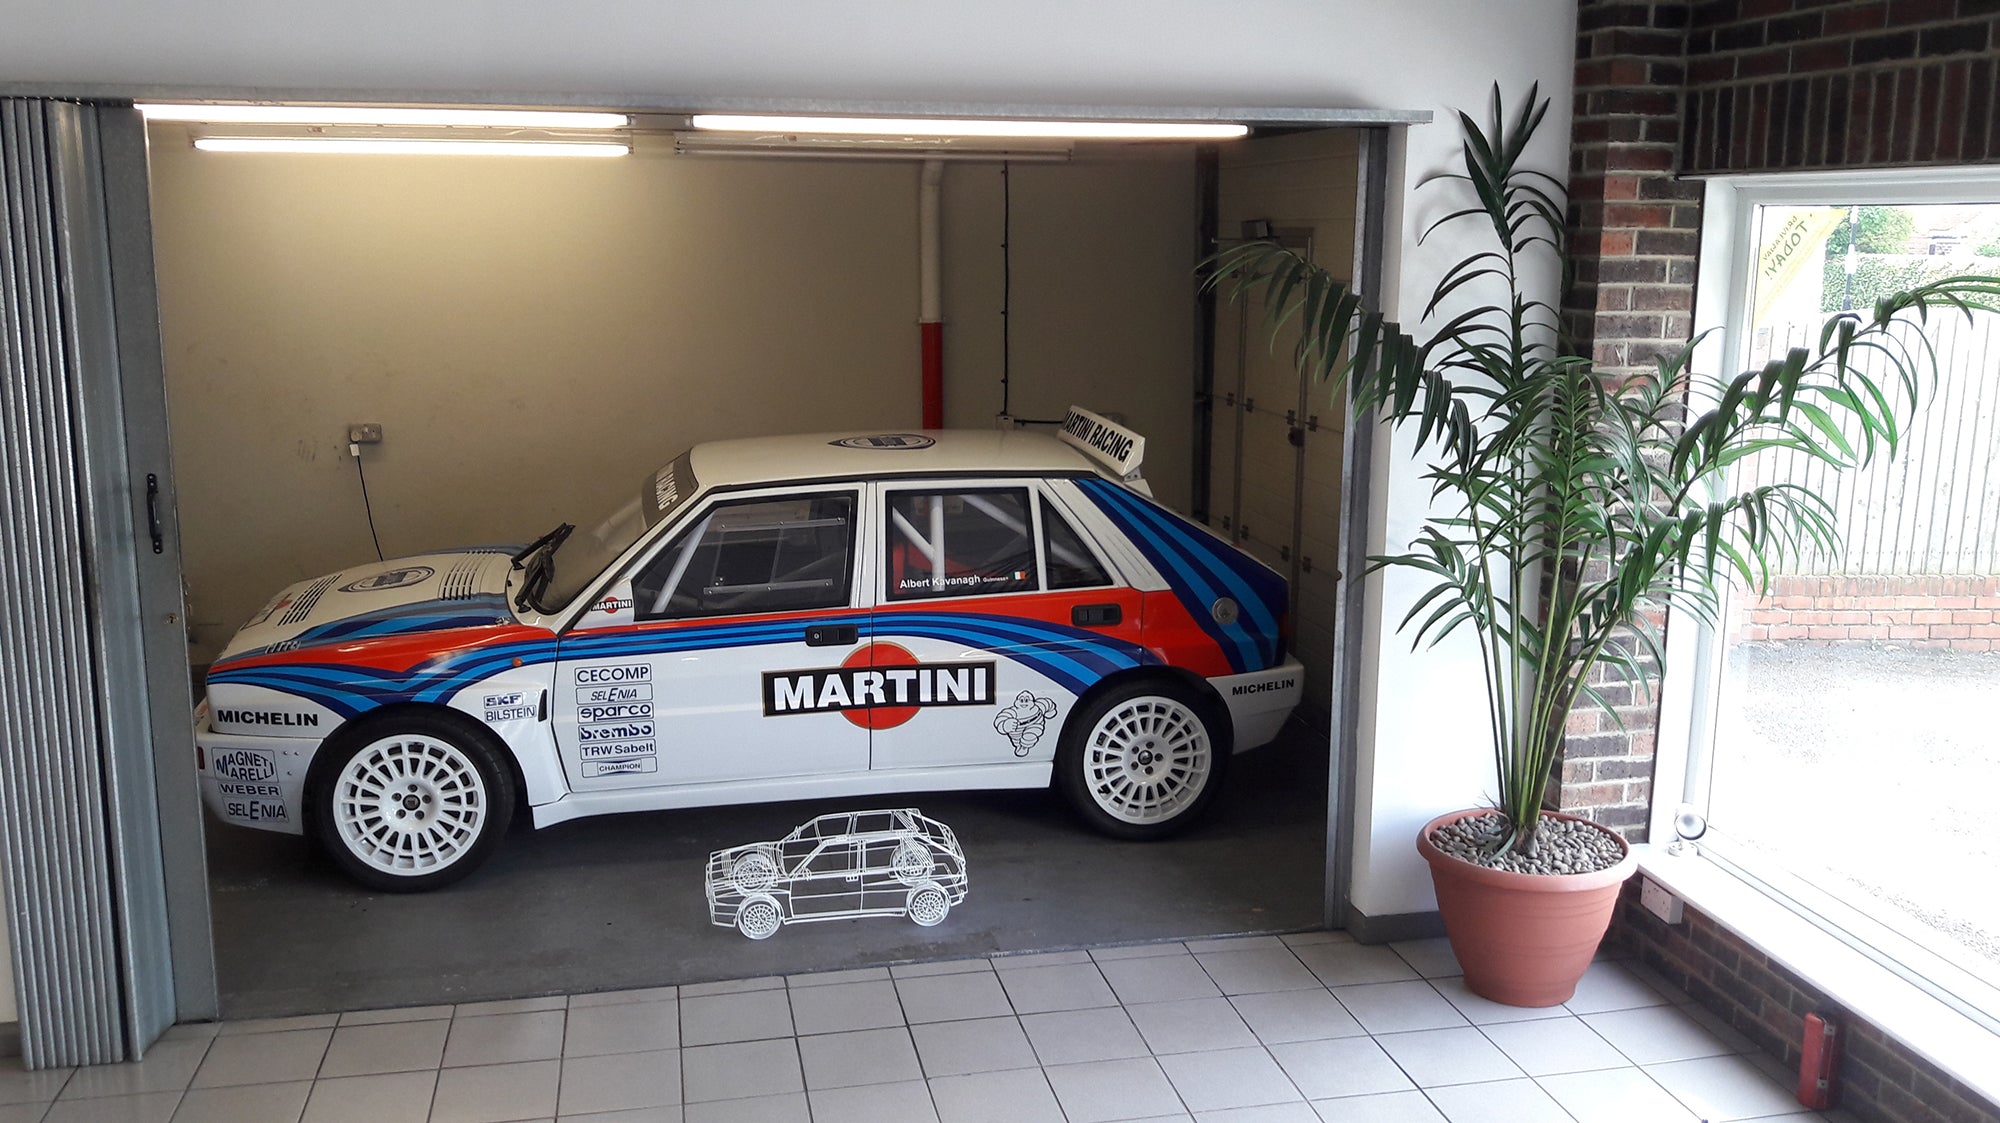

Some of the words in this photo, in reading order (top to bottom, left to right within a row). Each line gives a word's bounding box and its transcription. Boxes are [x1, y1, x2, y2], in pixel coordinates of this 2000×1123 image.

[1088, 423, 1134, 463] RACING
[899, 578, 930, 589] Albert
[931, 575, 981, 586] Kavanagh
[592, 600, 632, 611] MARTINI
[576, 666, 649, 683] CECOMP
[773, 667, 987, 711] MARTINI
[1232, 679, 1295, 696] MICHELIN
[485, 694, 522, 707] SKF
[217, 709, 319, 727] MICHELIN
[486, 706, 536, 722] BILSTEIN
[580, 704, 652, 722] sparco
[580, 723, 653, 740] brembo
[582, 745, 613, 757] TRW
[614, 742, 654, 755] Sabelt
[599, 763, 642, 772] CHAMPION
[220, 783, 280, 796] WEBER
